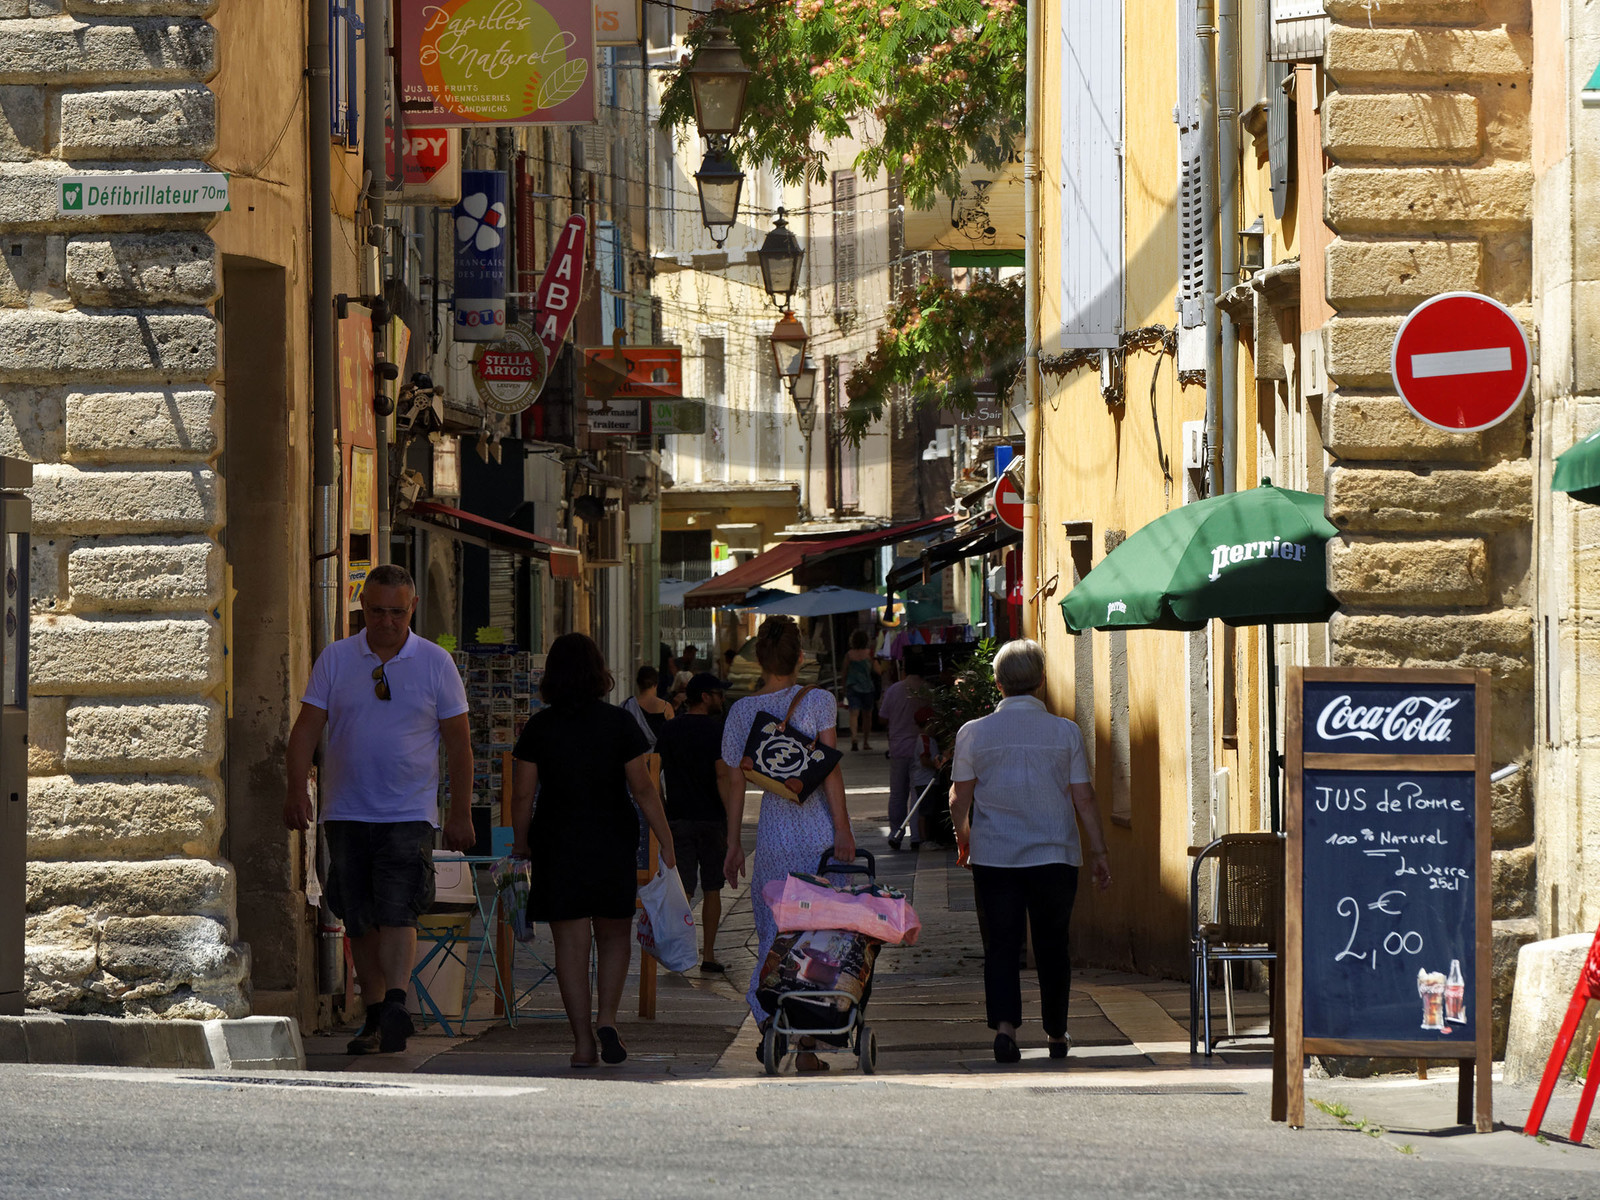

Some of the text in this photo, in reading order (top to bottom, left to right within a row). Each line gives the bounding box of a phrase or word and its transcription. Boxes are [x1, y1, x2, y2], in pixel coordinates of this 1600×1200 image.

[435, 30, 576, 79] Naturel
[404, 85, 423, 93] JUS
[444, 94, 511, 102] VIENNOISERIES
[457, 105, 508, 113] SANDWICHS
[88, 185, 226, 206] Défibrillateur 70m
[480, 271, 504, 279] JEUX
[541, 223, 581, 357] TABA
[456, 309, 505, 326] LOTO
[485, 355, 532, 366] STELLA
[484, 366, 533, 376] ARTOIS
[593, 421, 631, 429] traiteur
[1316, 695, 1460, 742] Coca-Cola
[1315, 786, 1367, 812] JUS
[1376, 788, 1402, 813] de
